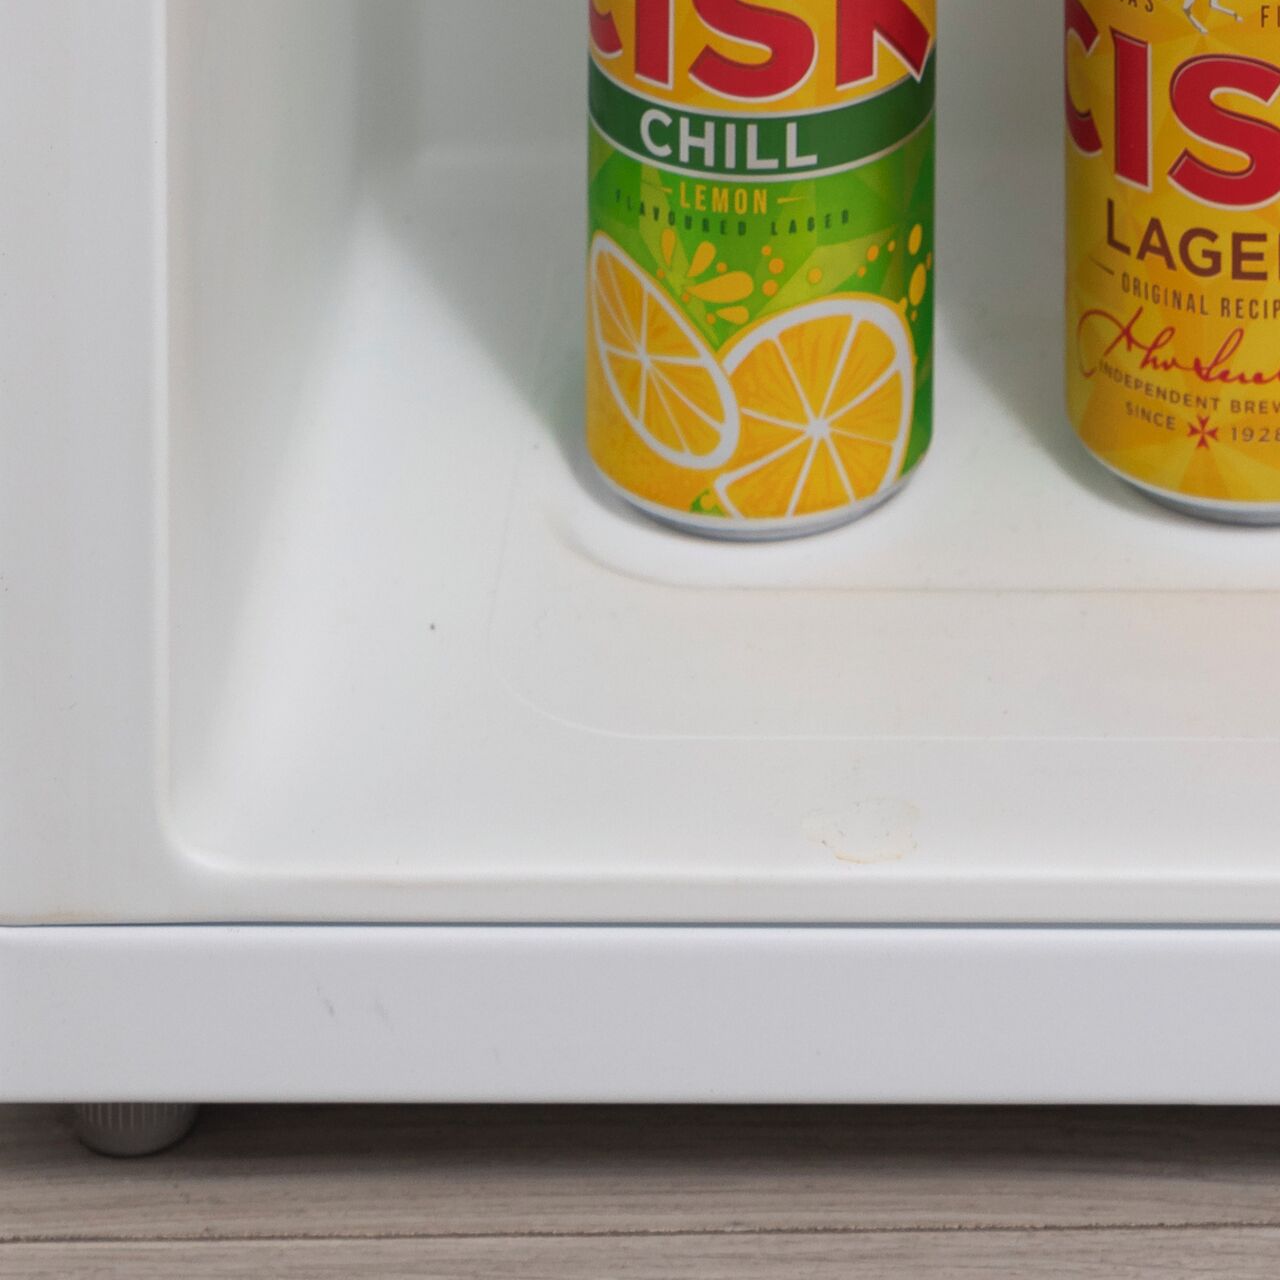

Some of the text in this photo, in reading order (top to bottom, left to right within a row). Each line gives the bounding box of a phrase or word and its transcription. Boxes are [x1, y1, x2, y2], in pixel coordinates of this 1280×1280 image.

[640, 109, 818, 169] CHILL
[616, 190, 848, 236] FLAVOURED LAGER
[679, 182, 768, 214] LEMON
[1121, 272, 1209, 316] ORIGINAL
[1100, 360, 1220, 411] INDEPENDENT
[1126, 401, 1176, 430] SINCE
